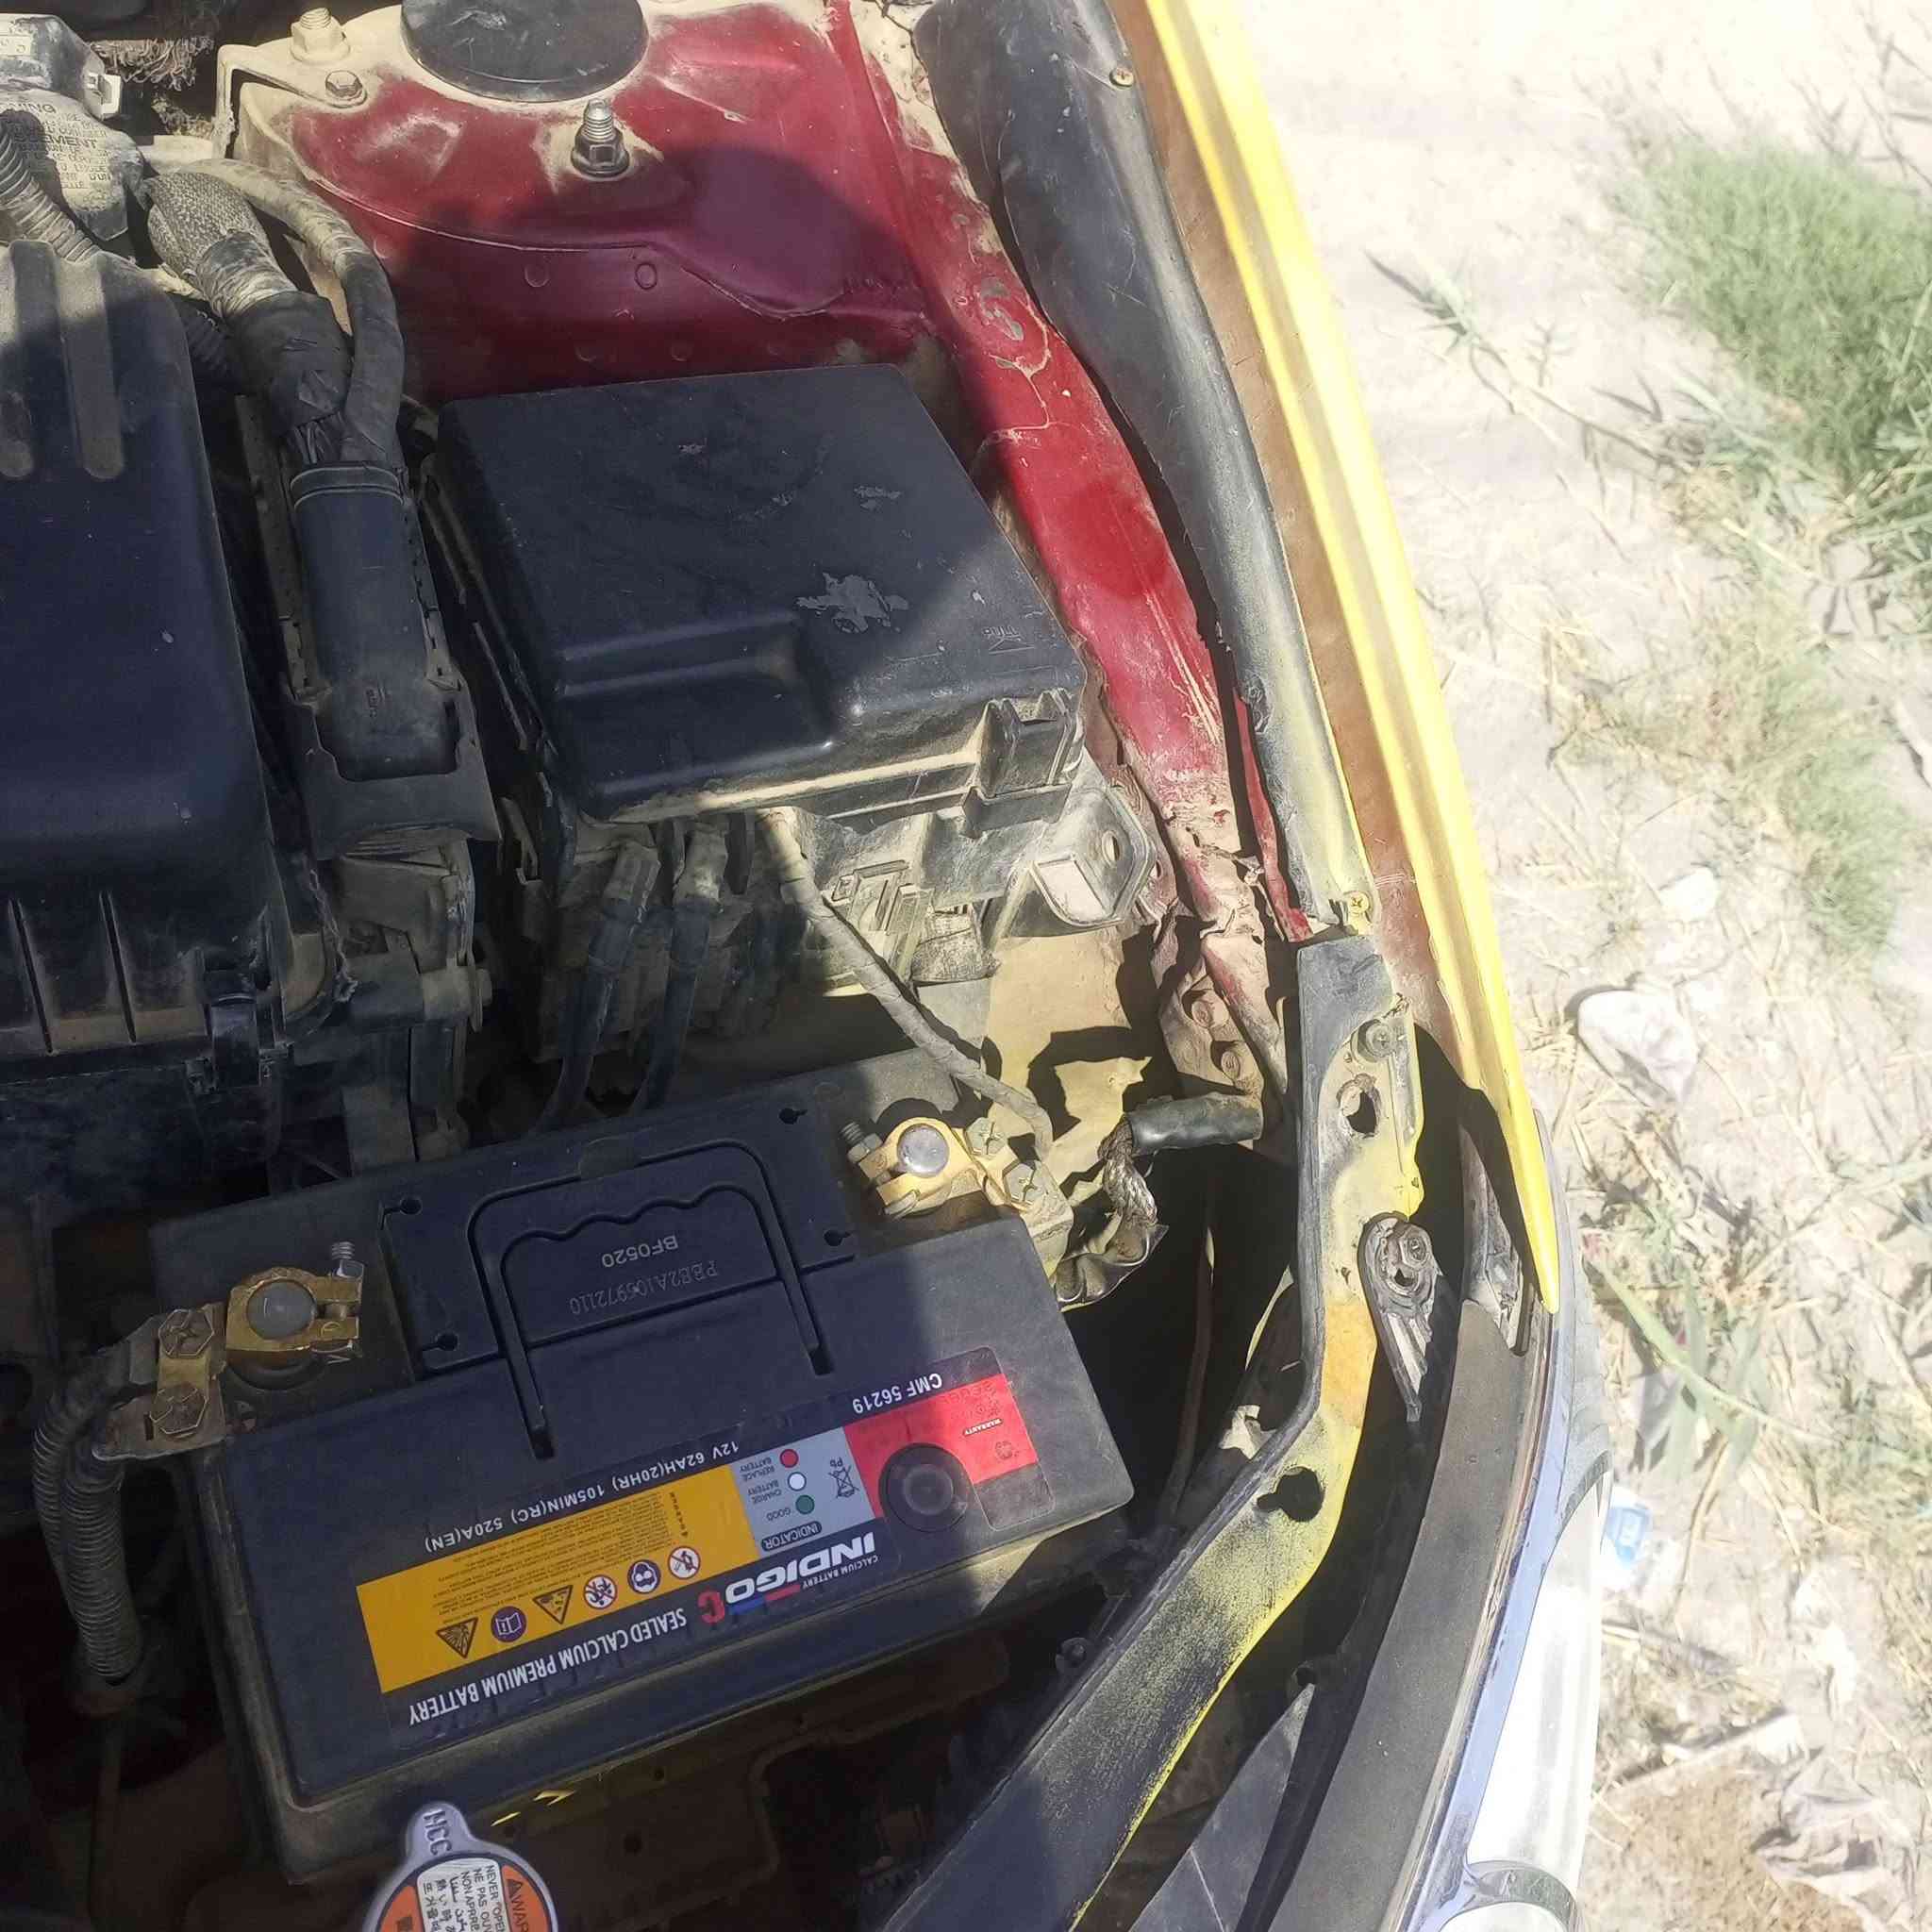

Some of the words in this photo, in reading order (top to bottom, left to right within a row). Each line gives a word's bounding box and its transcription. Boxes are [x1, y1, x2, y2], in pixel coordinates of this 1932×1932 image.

[600, 1234, 678, 1268] BF0520
[850, 1384, 902, 1415] 56219
[904, 1371, 943, 1397] CMF
[709, 1439, 739, 1458] 12V
[828, 1456, 843, 1469] Pb
[609, 1450, 705, 1491] 62AH(20HR)
[508, 1483, 605, 1524] 105MIN(RC)
[765, 1506, 791, 1522] GOOD
[423, 1516, 503, 1553] 520A(EN)
[762, 1522, 819, 1551] INDICATOR
[725, 1532, 876, 1604] INDIGO
[800, 1568, 840, 1589] BATTERY
[840, 1554, 878, 1574] CALCIUM
[628, 1607, 688, 1643] SEALED
[557, 1627, 629, 1670] CALCIUM
[479, 1654, 558, 1697] PREMIUM
[403, 1681, 480, 1725] BATTERY
[460, 1871, 473, 1894] NON
[476, 1888, 488, 1907] PAS
[485, 1864, 500, 1901] NEVER
